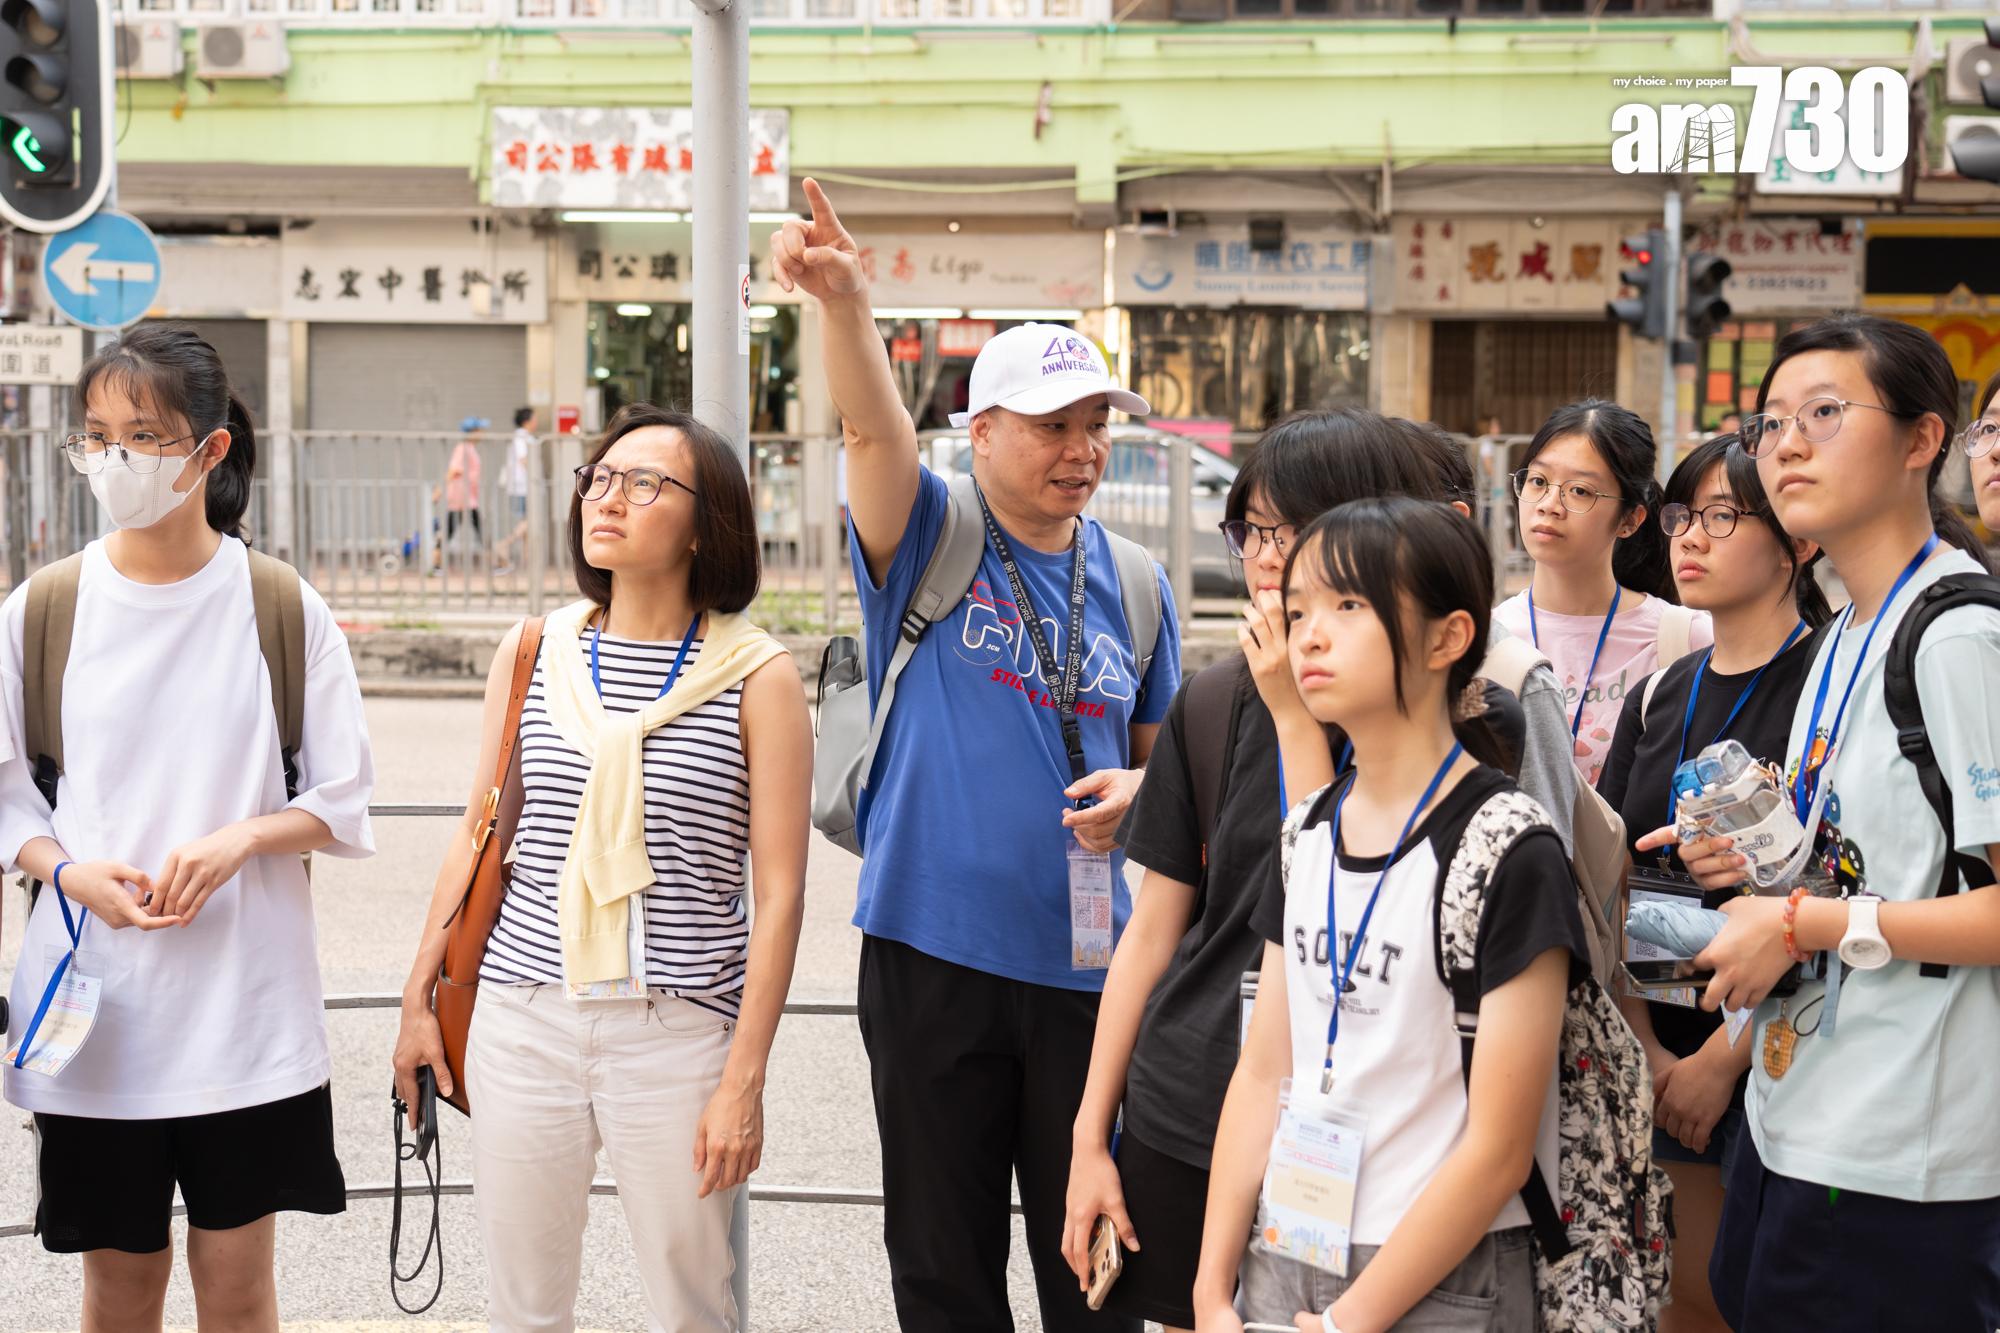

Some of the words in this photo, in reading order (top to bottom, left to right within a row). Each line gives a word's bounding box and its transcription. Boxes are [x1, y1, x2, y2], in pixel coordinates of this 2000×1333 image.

[1076, 549, 1086, 595] SURVEYORS
[1008, 573, 1032, 621] SURVEYORS
[1067, 652, 1081, 703] SURVEYORS
[1565, 669, 1626, 704] ead
